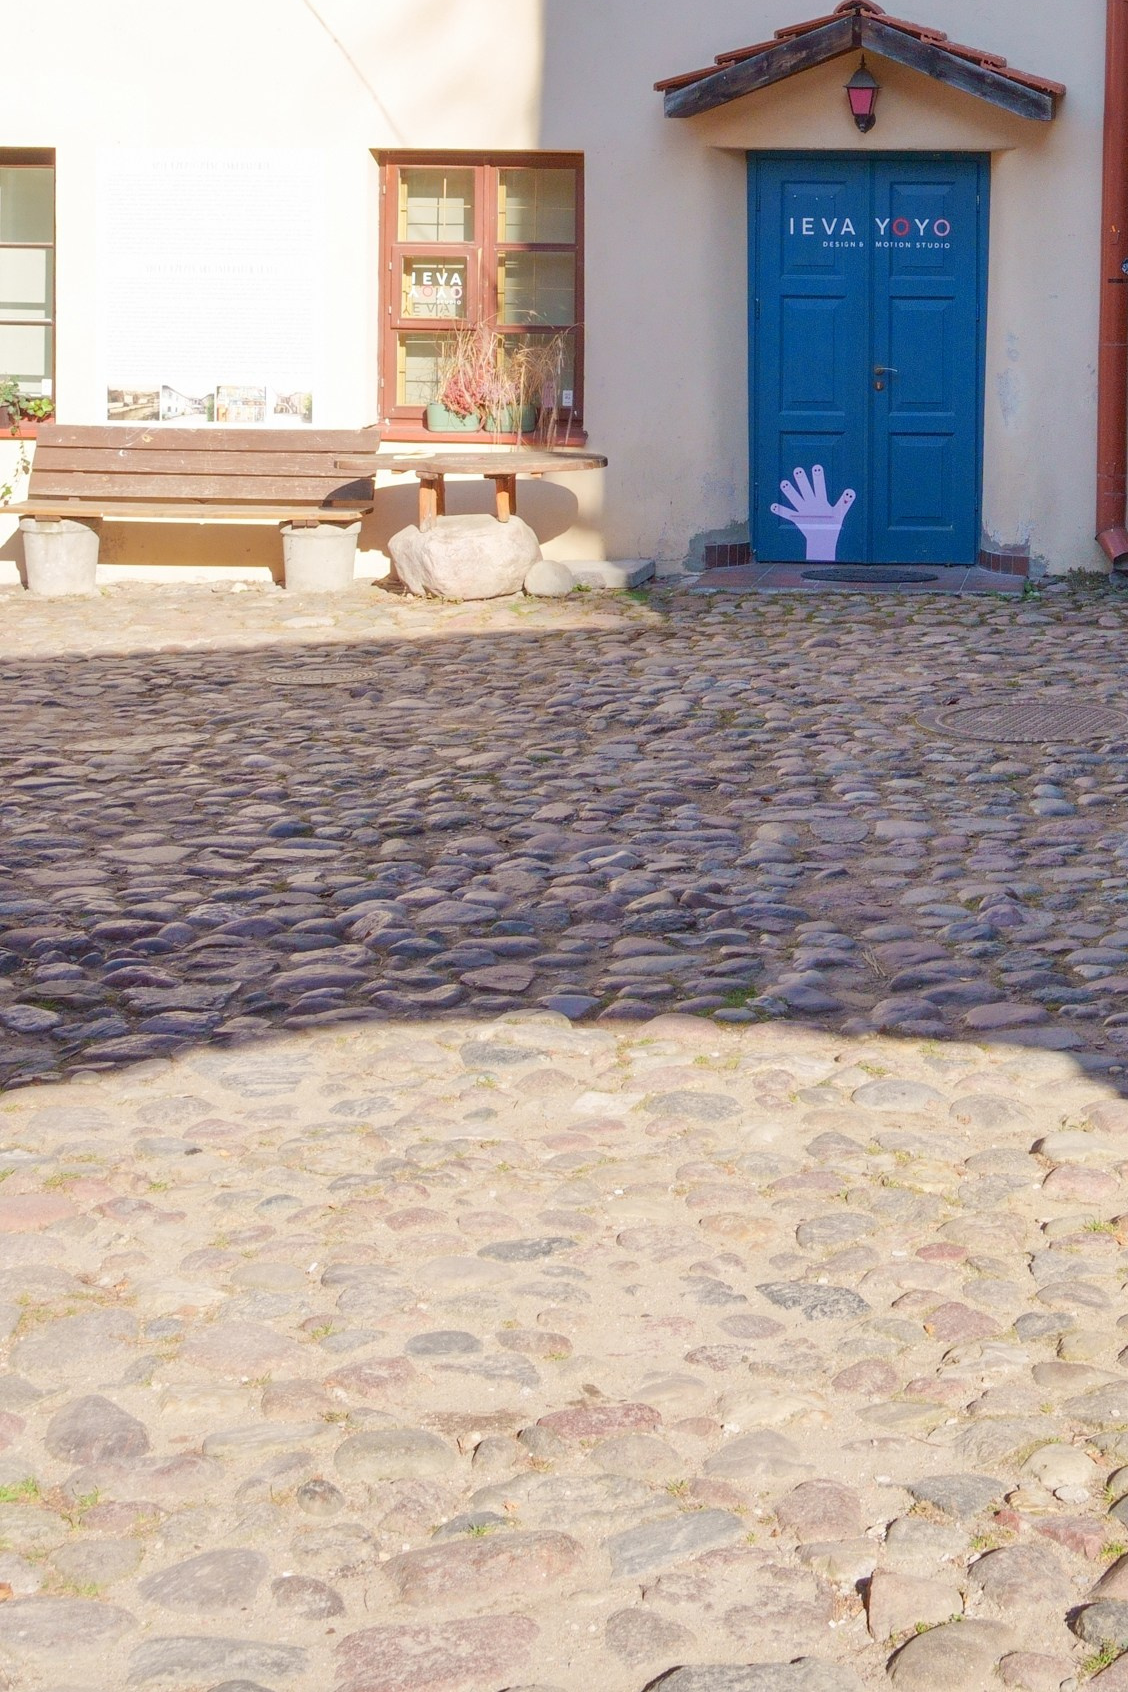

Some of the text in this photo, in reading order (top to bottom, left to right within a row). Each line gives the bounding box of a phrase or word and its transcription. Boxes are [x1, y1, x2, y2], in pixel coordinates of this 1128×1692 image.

[789, 217, 950, 236] IEVA YOYO
[412, 272, 462, 285] IEVA
